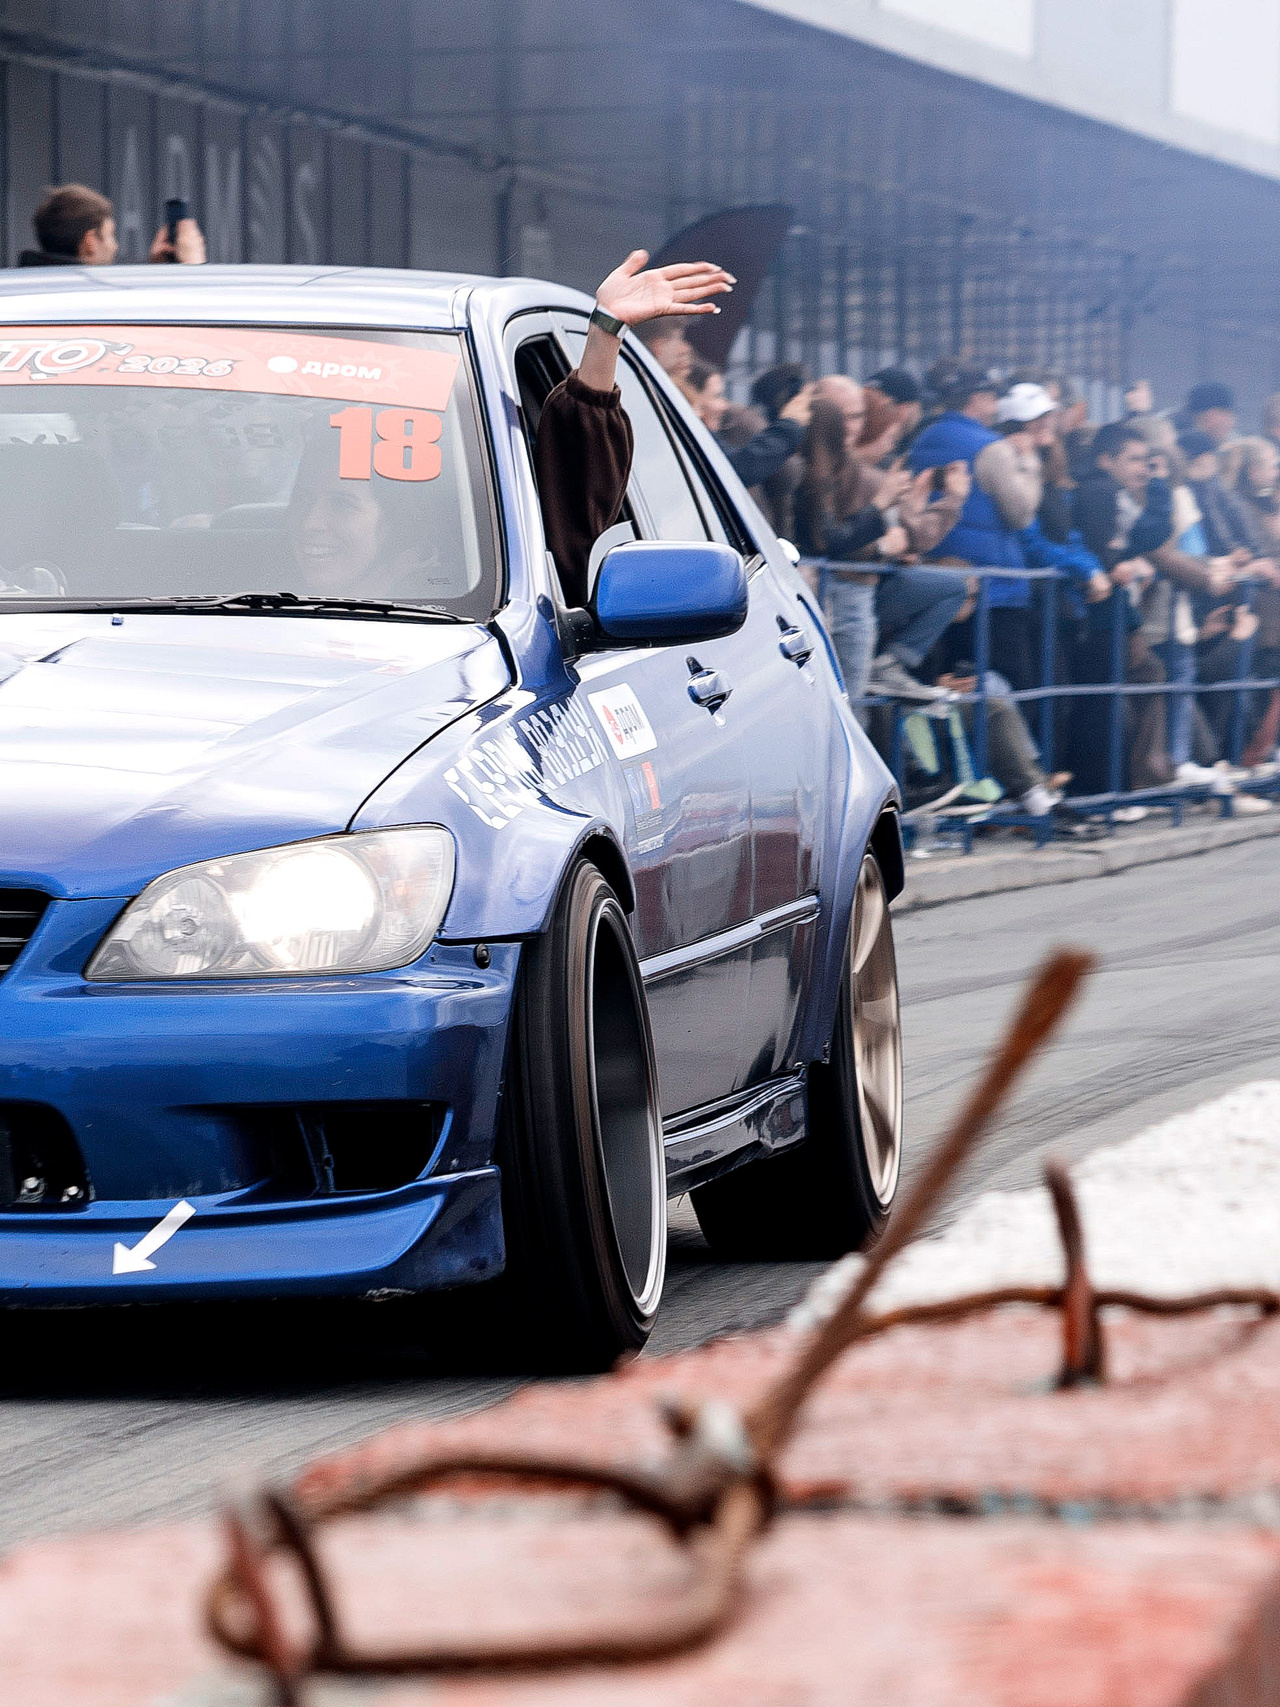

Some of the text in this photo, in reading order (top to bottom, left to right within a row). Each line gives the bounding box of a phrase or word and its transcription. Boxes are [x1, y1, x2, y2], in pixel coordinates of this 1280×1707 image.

[117, 355, 235, 377] 2026
[301, 361, 382, 381] дром
[329, 407, 443, 481] 18
